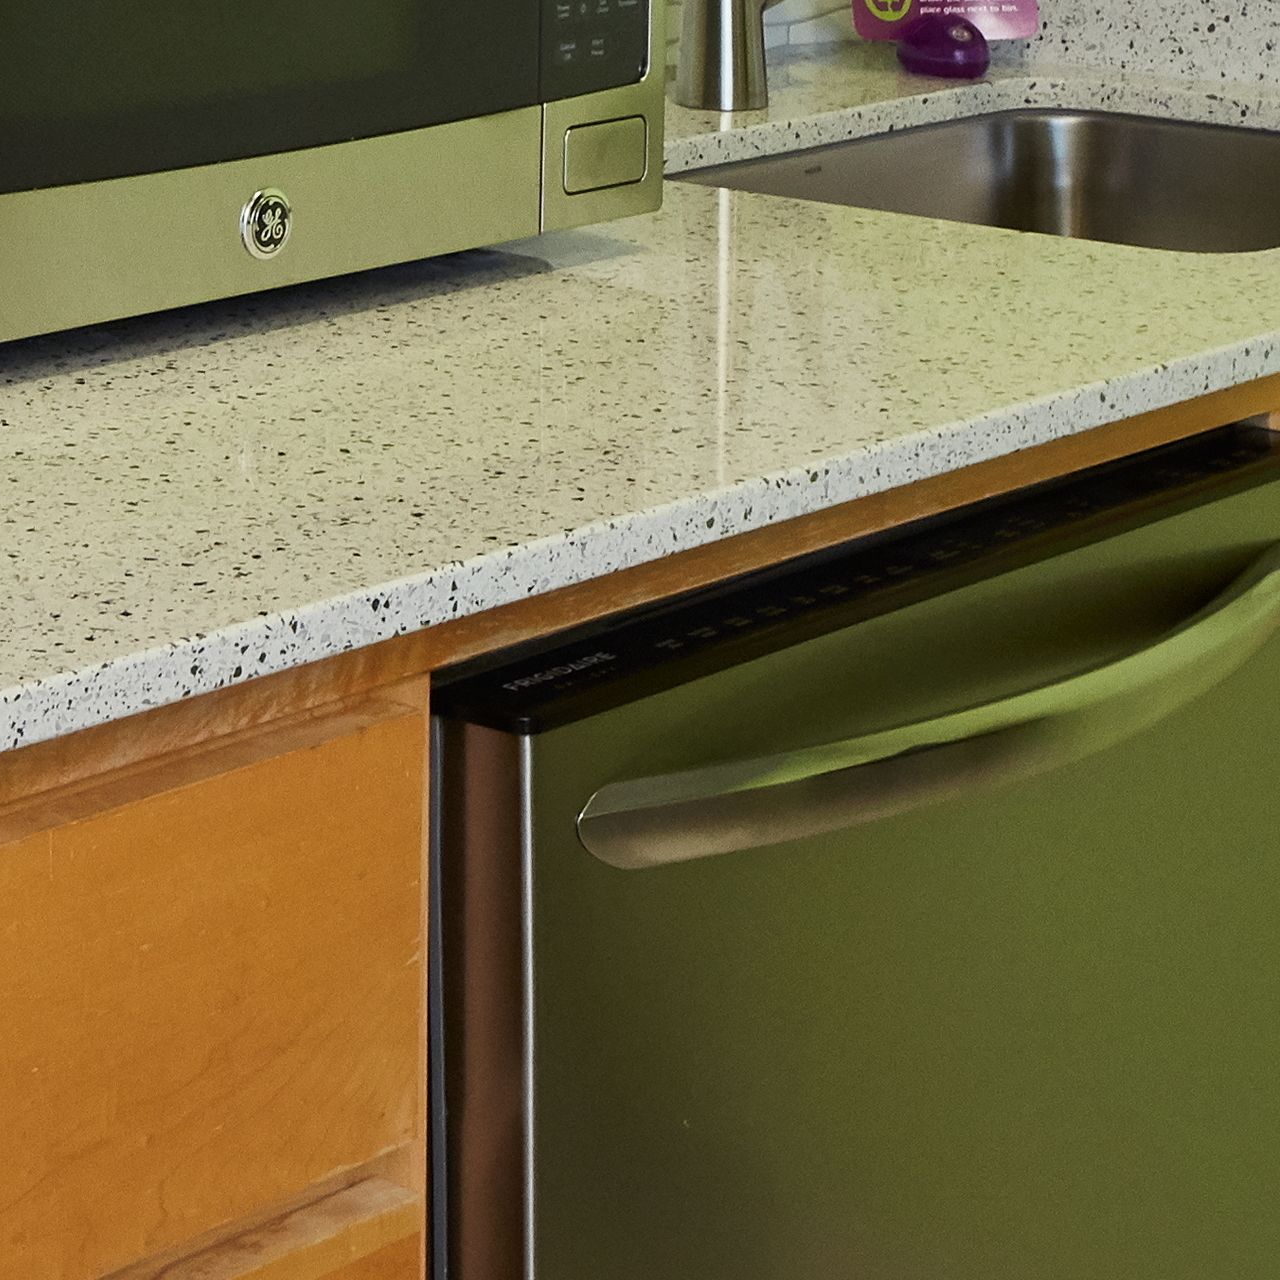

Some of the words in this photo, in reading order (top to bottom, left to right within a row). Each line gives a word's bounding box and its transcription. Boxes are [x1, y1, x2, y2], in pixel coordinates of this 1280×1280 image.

[920, 5, 942, 15] place
[943, 5, 965, 15] glass
[966, 5, 988, 13] next
[989, 5, 1000, 13] to
[501, 651, 618, 692] FRIGIDAIRE
